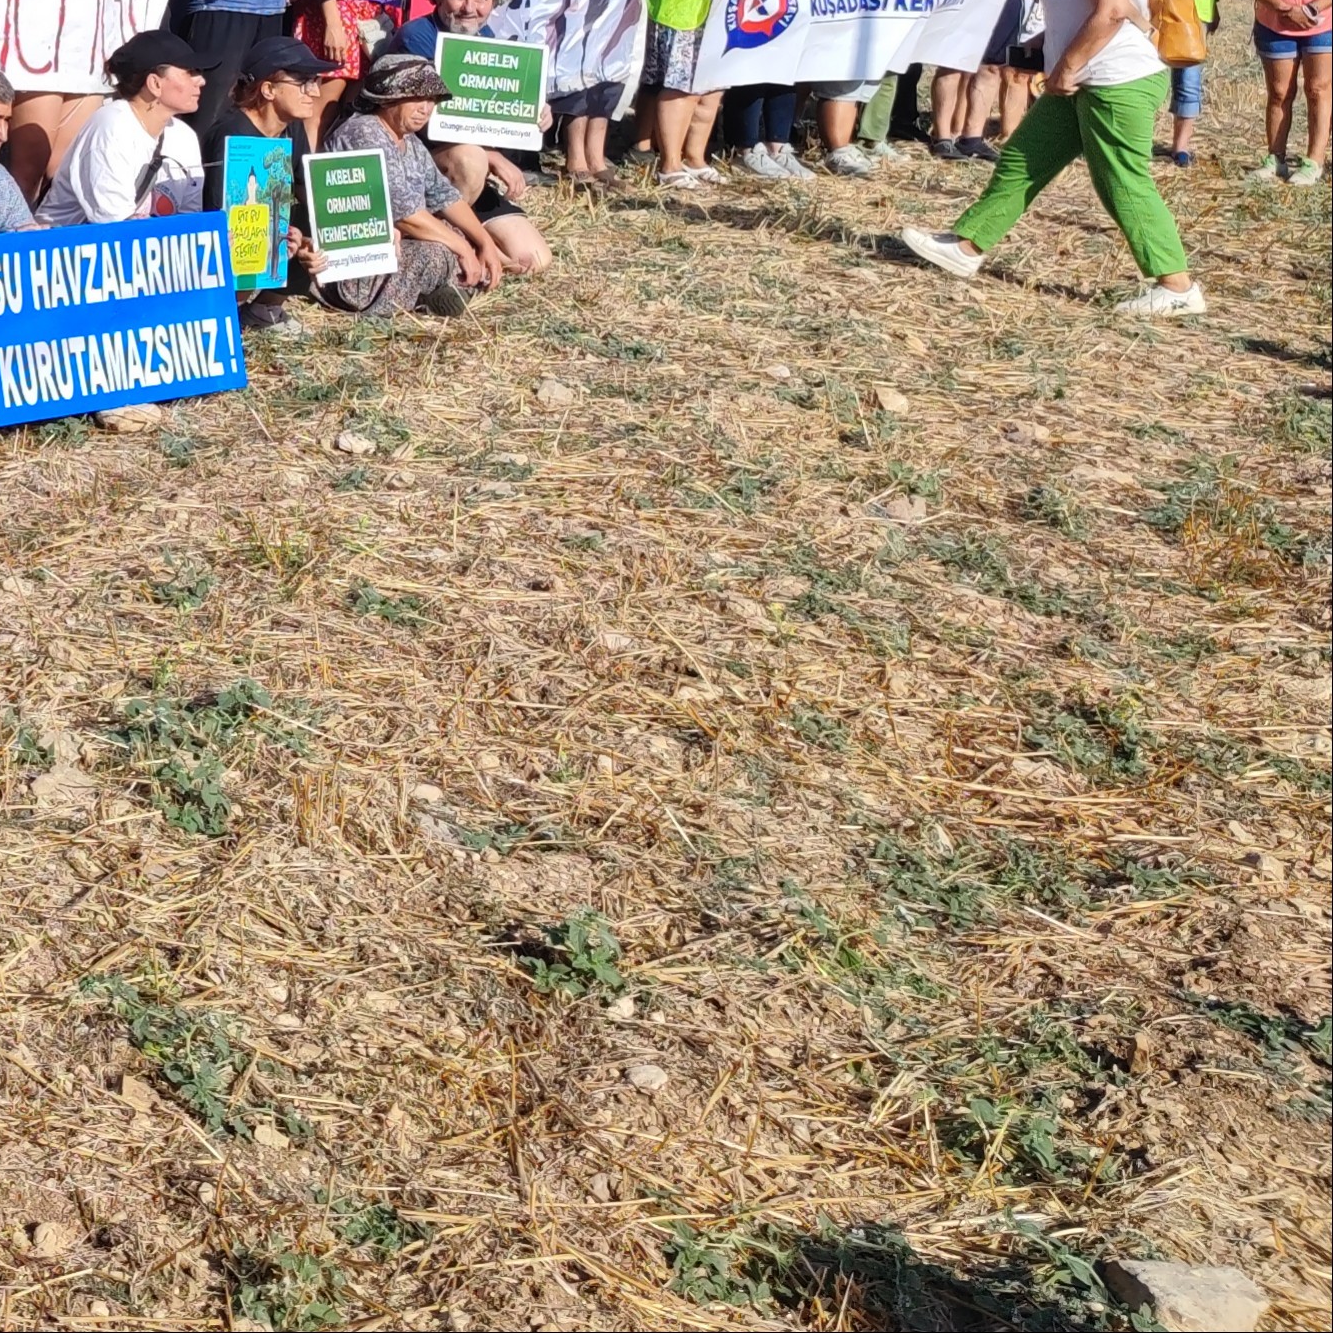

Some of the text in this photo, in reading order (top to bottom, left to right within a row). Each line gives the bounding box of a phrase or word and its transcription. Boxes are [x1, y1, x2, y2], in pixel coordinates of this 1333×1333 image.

[462, 51, 519, 69] AKBELEN
[458, 73, 520, 93] ORMANINI
[326, 167, 366, 186] AKBELEN
[327, 194, 371, 214] ORMANINI
[29, 230, 225, 310] HAVZALARIMIZI
